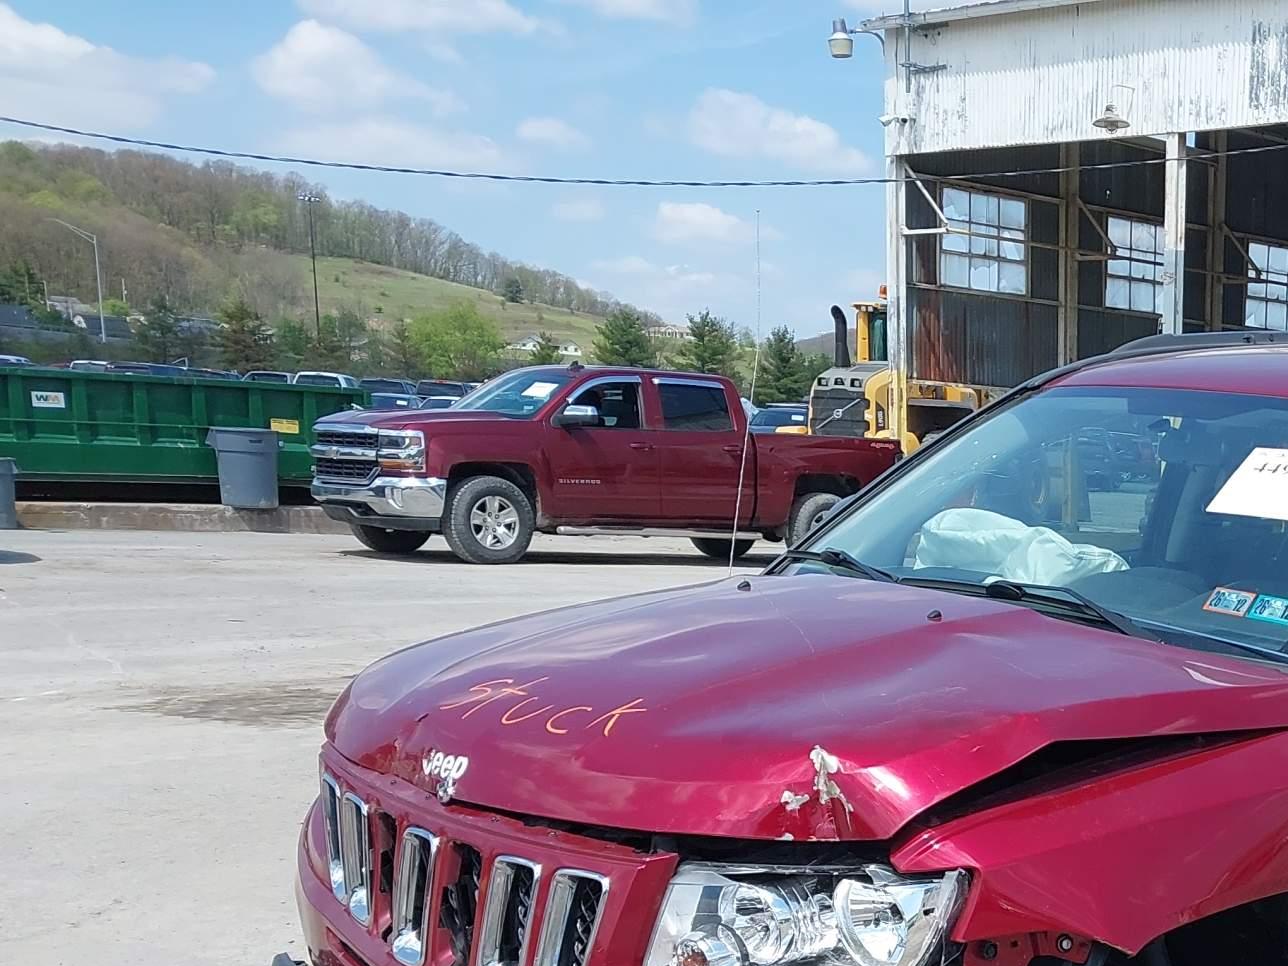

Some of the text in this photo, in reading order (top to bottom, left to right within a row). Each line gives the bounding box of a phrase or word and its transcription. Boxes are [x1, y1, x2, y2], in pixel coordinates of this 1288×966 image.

[1209, 591, 1247, 612] 26 12
[1254, 599, 1270, 615] 26
[422, 748, 469, 779] Jeep
